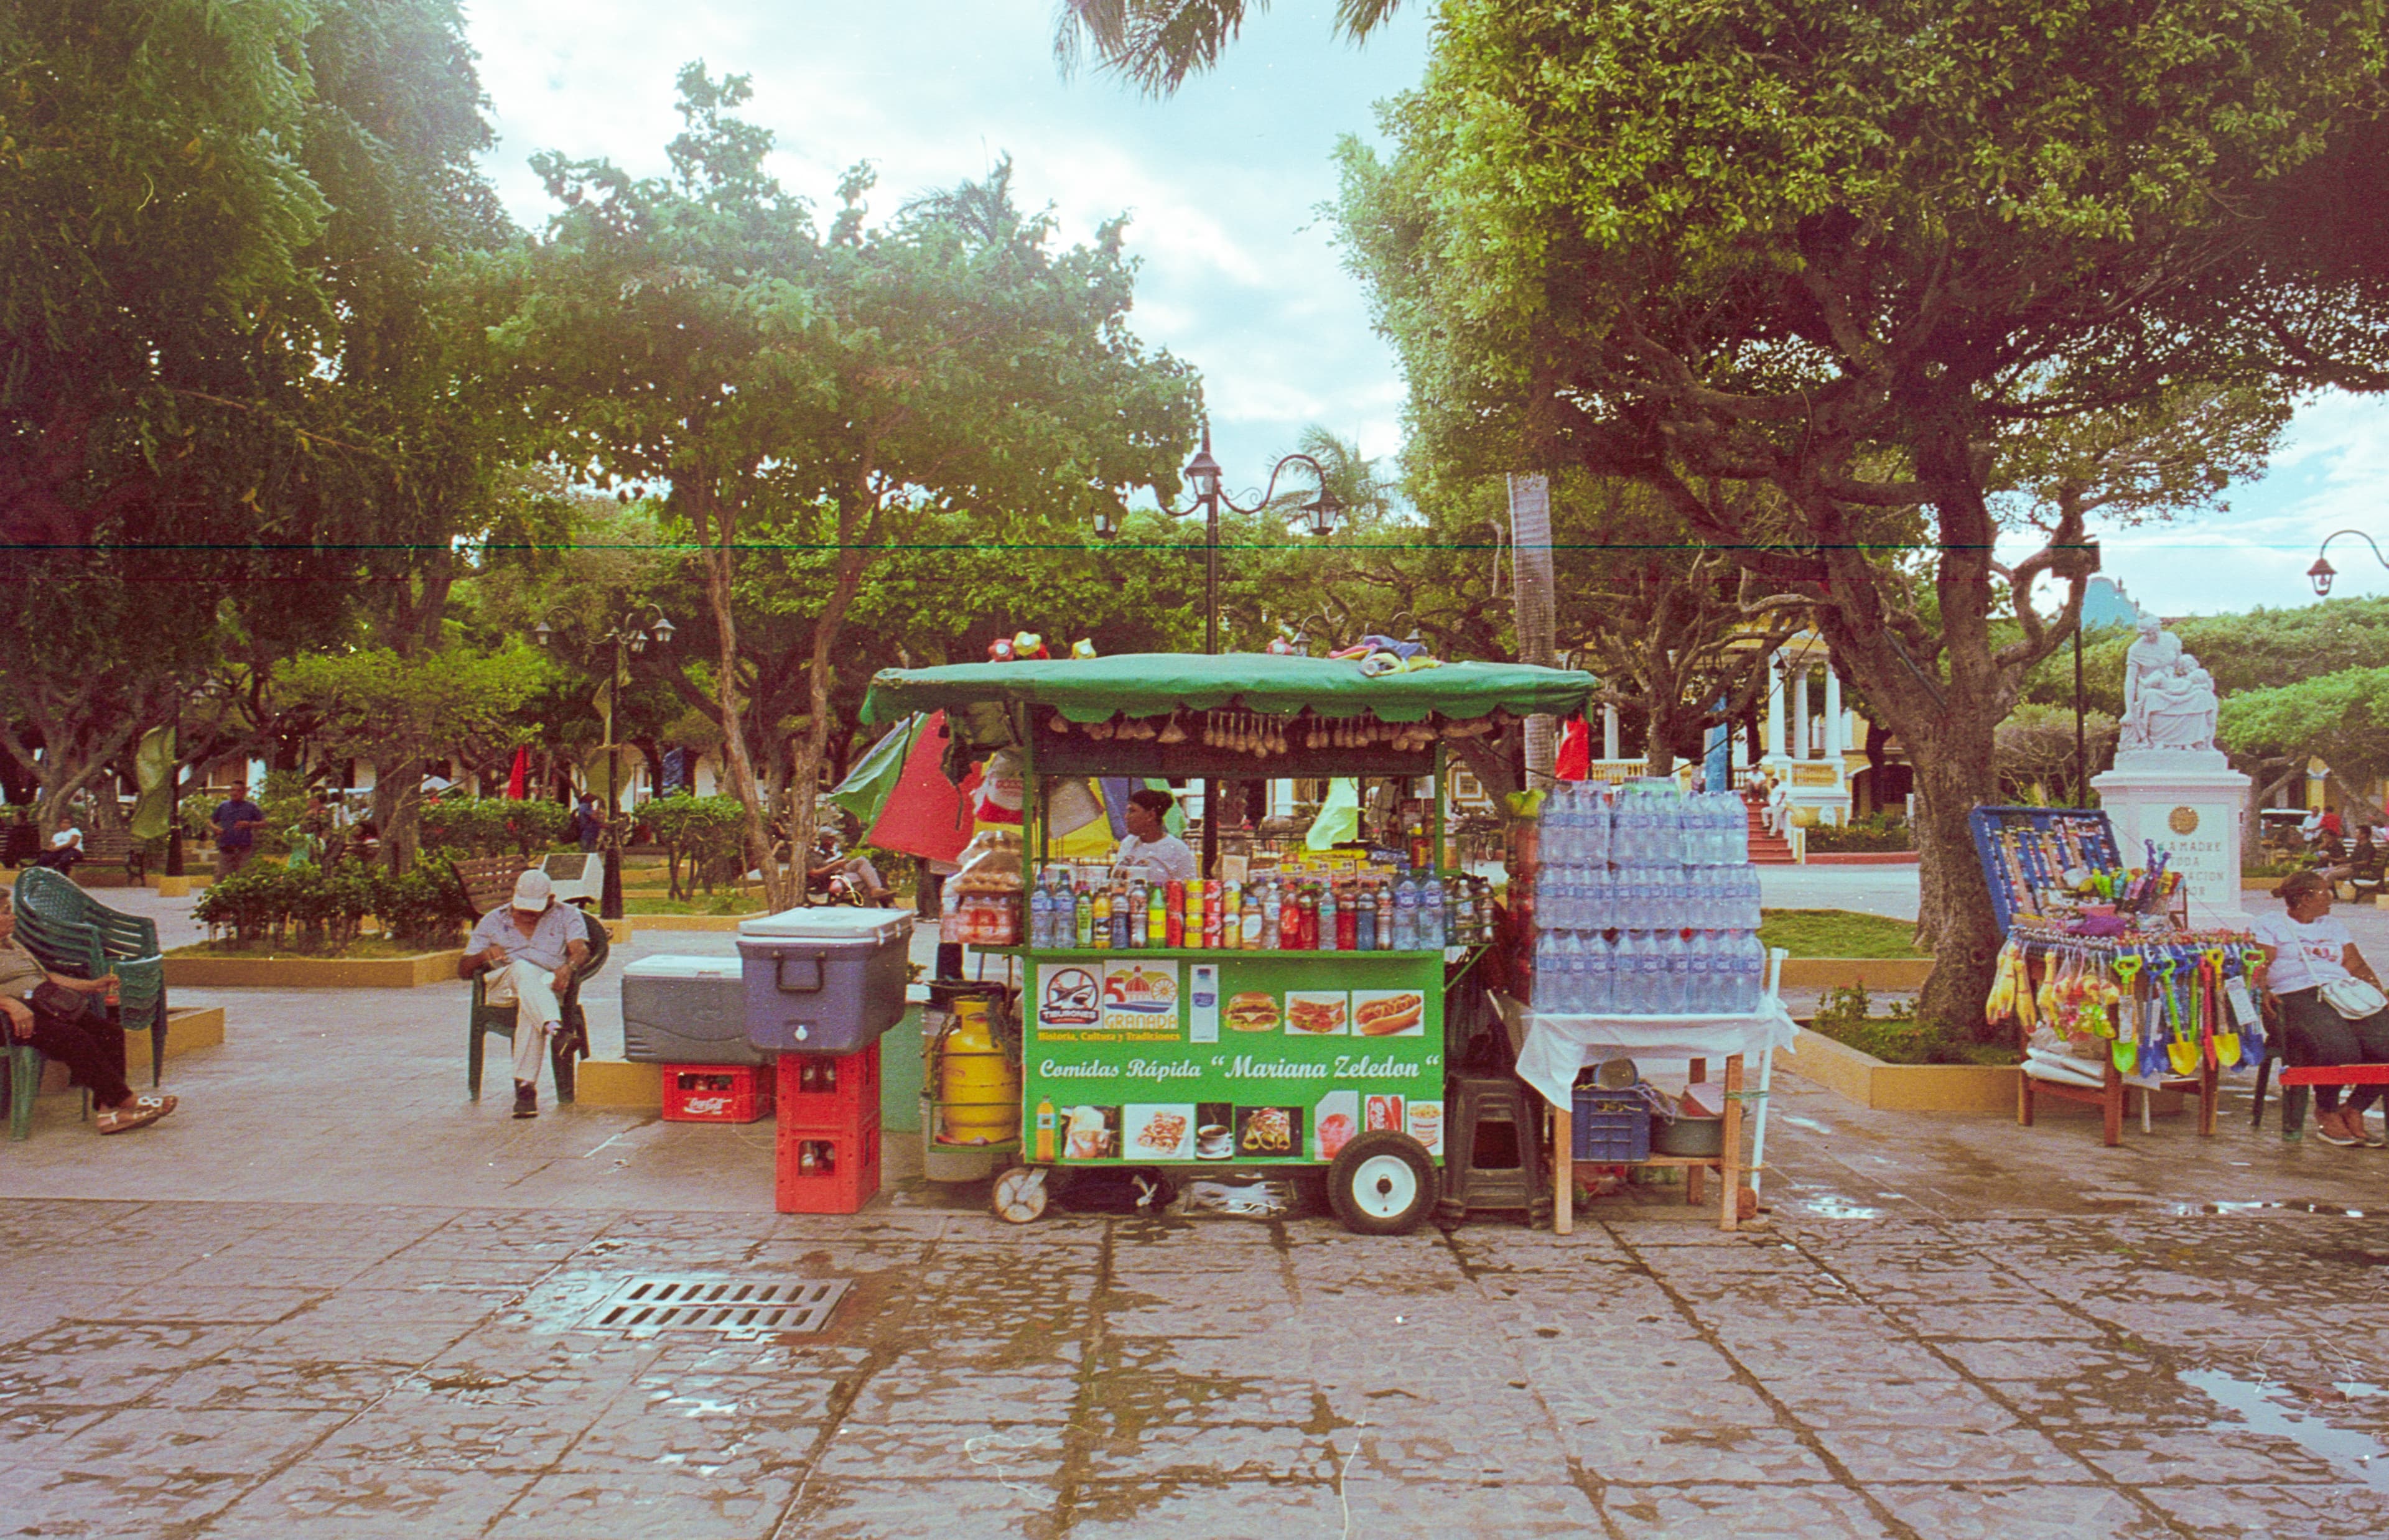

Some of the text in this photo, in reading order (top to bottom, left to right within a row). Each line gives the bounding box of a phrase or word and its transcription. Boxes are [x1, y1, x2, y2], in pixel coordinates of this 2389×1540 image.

[2180, 842, 2220, 851] MADRE
[2188, 871, 2224, 881] ACION
[1104, 1014, 1178, 1029] GRANADA
[1125, 1031, 1181, 1041] Tradiciones
[1039, 1059, 1119, 1078] Comidas
[1125, 1059, 1201, 1083] Rápida
